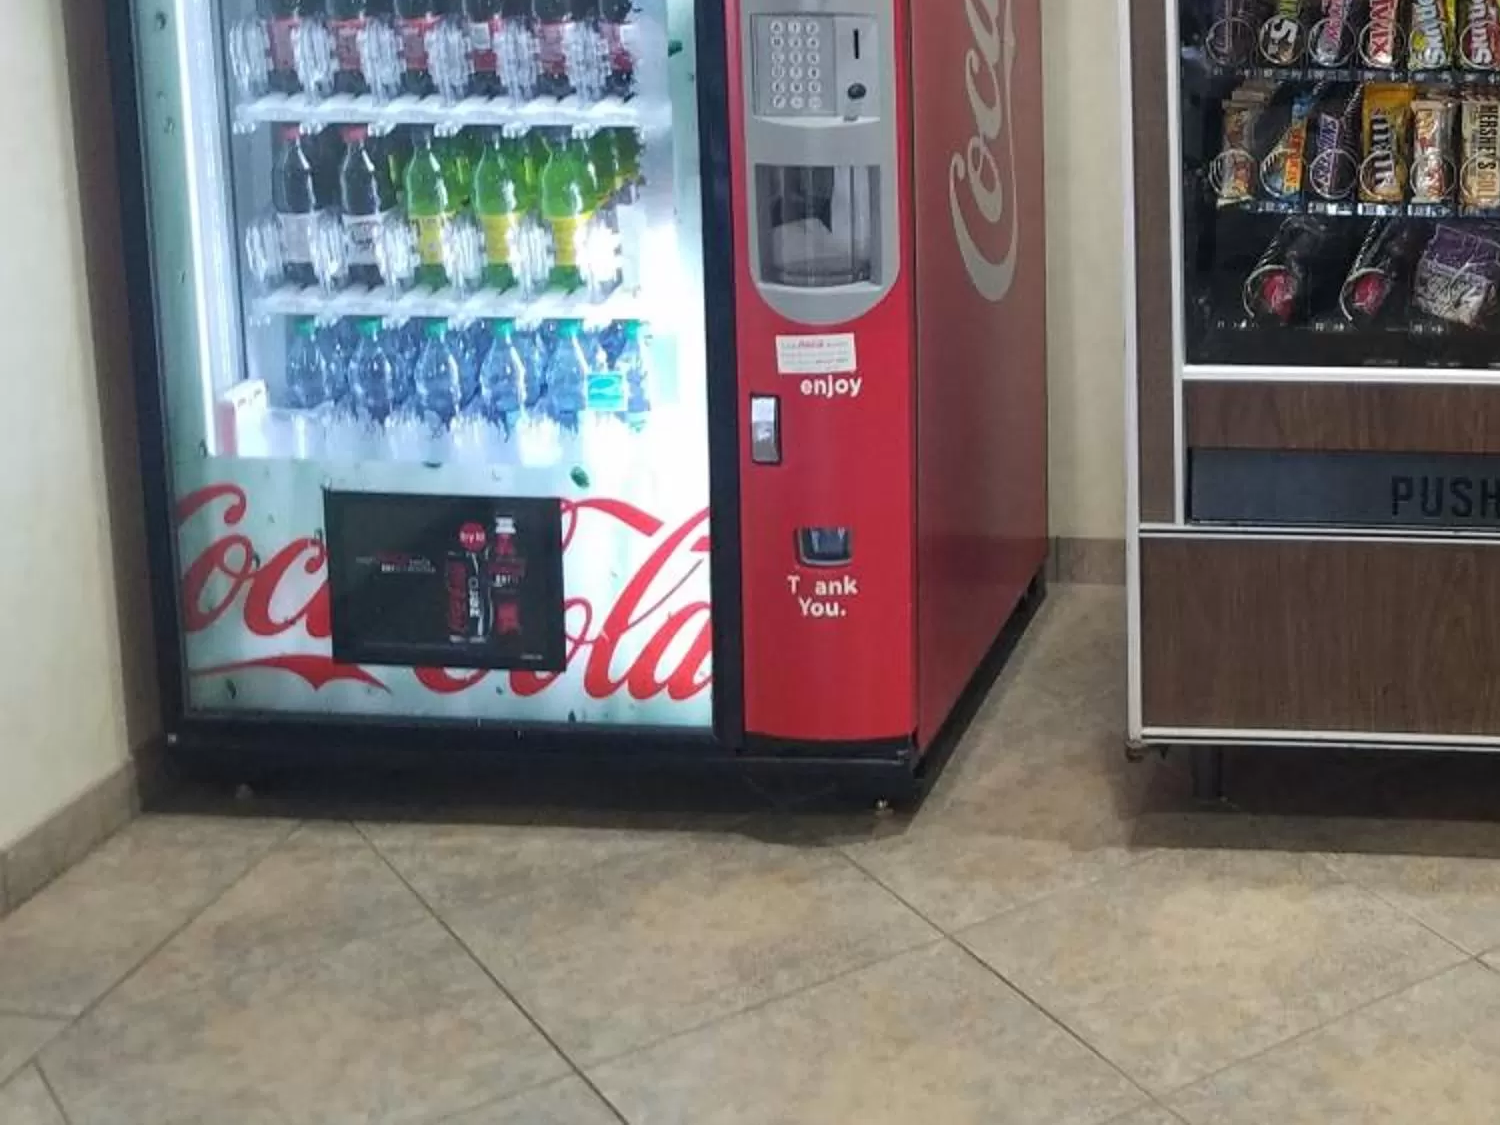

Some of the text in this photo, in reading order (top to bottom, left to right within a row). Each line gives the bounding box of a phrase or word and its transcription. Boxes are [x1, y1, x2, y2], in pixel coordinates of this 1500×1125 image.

[800, 373, 862, 398] enjoy
[787, 575, 858, 596] Tank
[799, 597, 847, 618] You.
